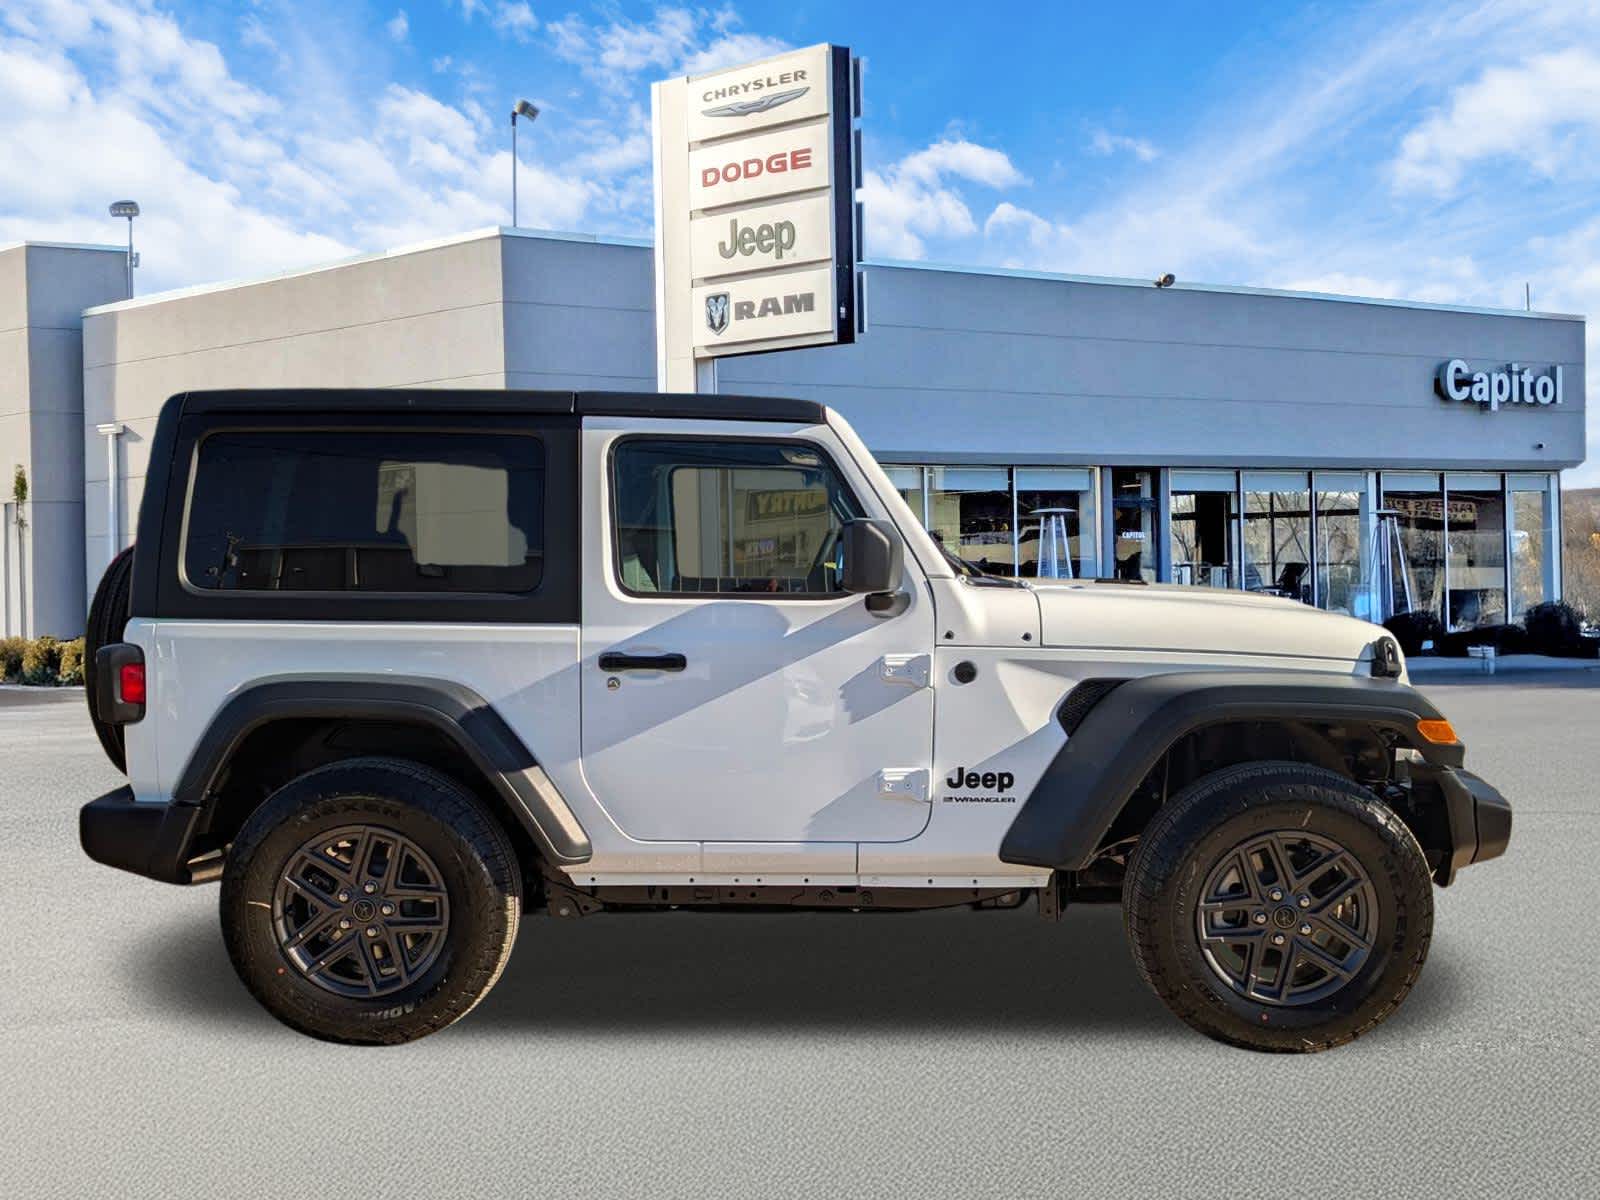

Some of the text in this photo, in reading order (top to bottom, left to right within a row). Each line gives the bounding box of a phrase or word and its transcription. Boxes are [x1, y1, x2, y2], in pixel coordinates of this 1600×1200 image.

[702, 69, 808, 103] CHRYSLER
[701, 147, 813, 188] DODGE
[718, 218, 796, 260] Jeep
[734, 292, 815, 321] RAM
[1445, 358, 1563, 412] Capitol
[946, 766, 1015, 793] Jeep
